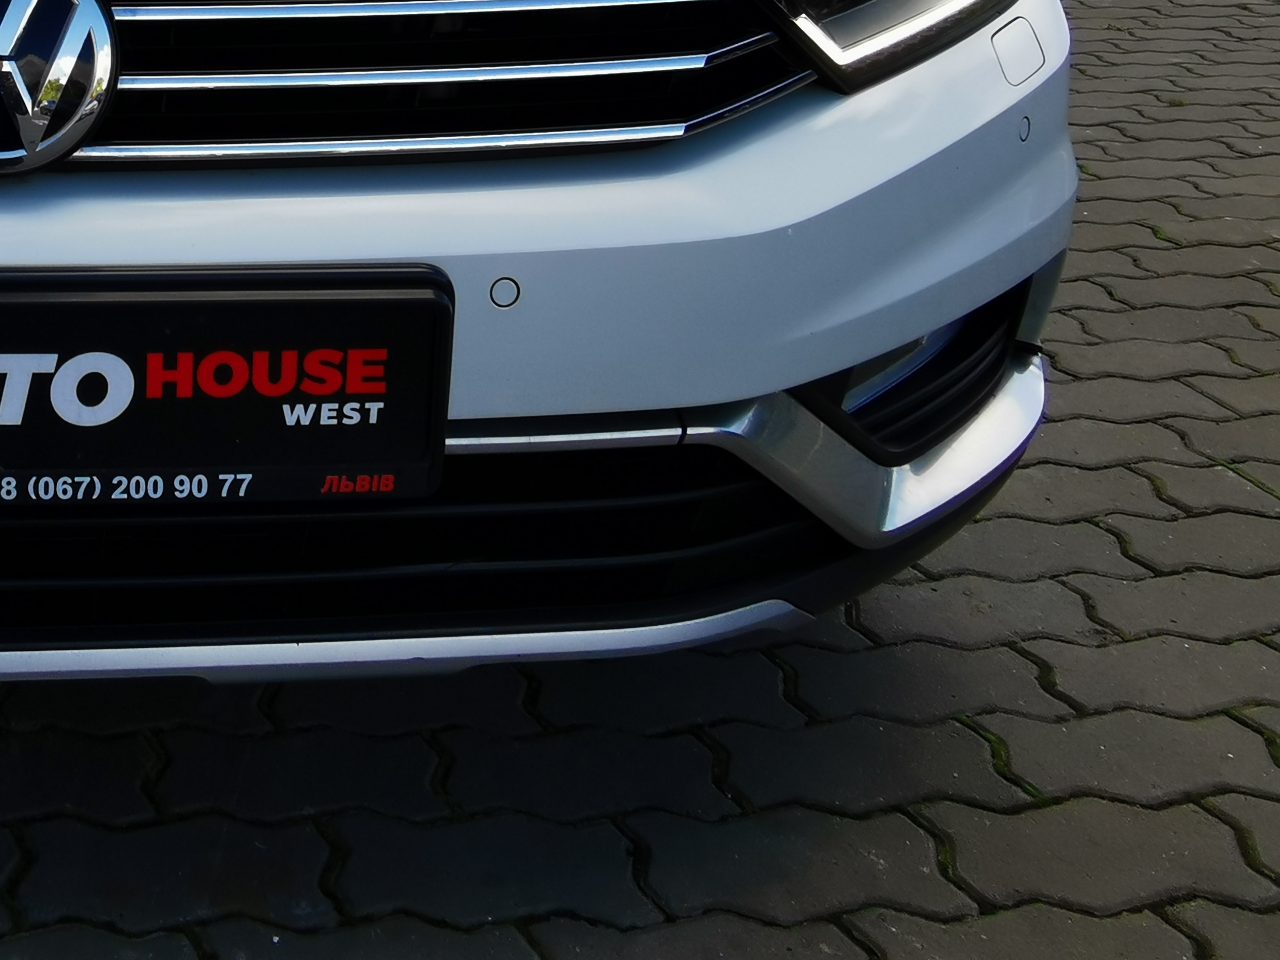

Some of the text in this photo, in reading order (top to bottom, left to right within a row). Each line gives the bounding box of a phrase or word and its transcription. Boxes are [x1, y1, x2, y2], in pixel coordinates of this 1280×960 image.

[145, 348, 388, 399] HOUSE
[282, 402, 384, 426] WEST
[27, 475, 101, 500] (067)
[111, 475, 164, 500] 200
[173, 474, 208, 499] 90
[219, 473, 253, 498] 77
[321, 474, 395, 494] ЛЬВІВ
